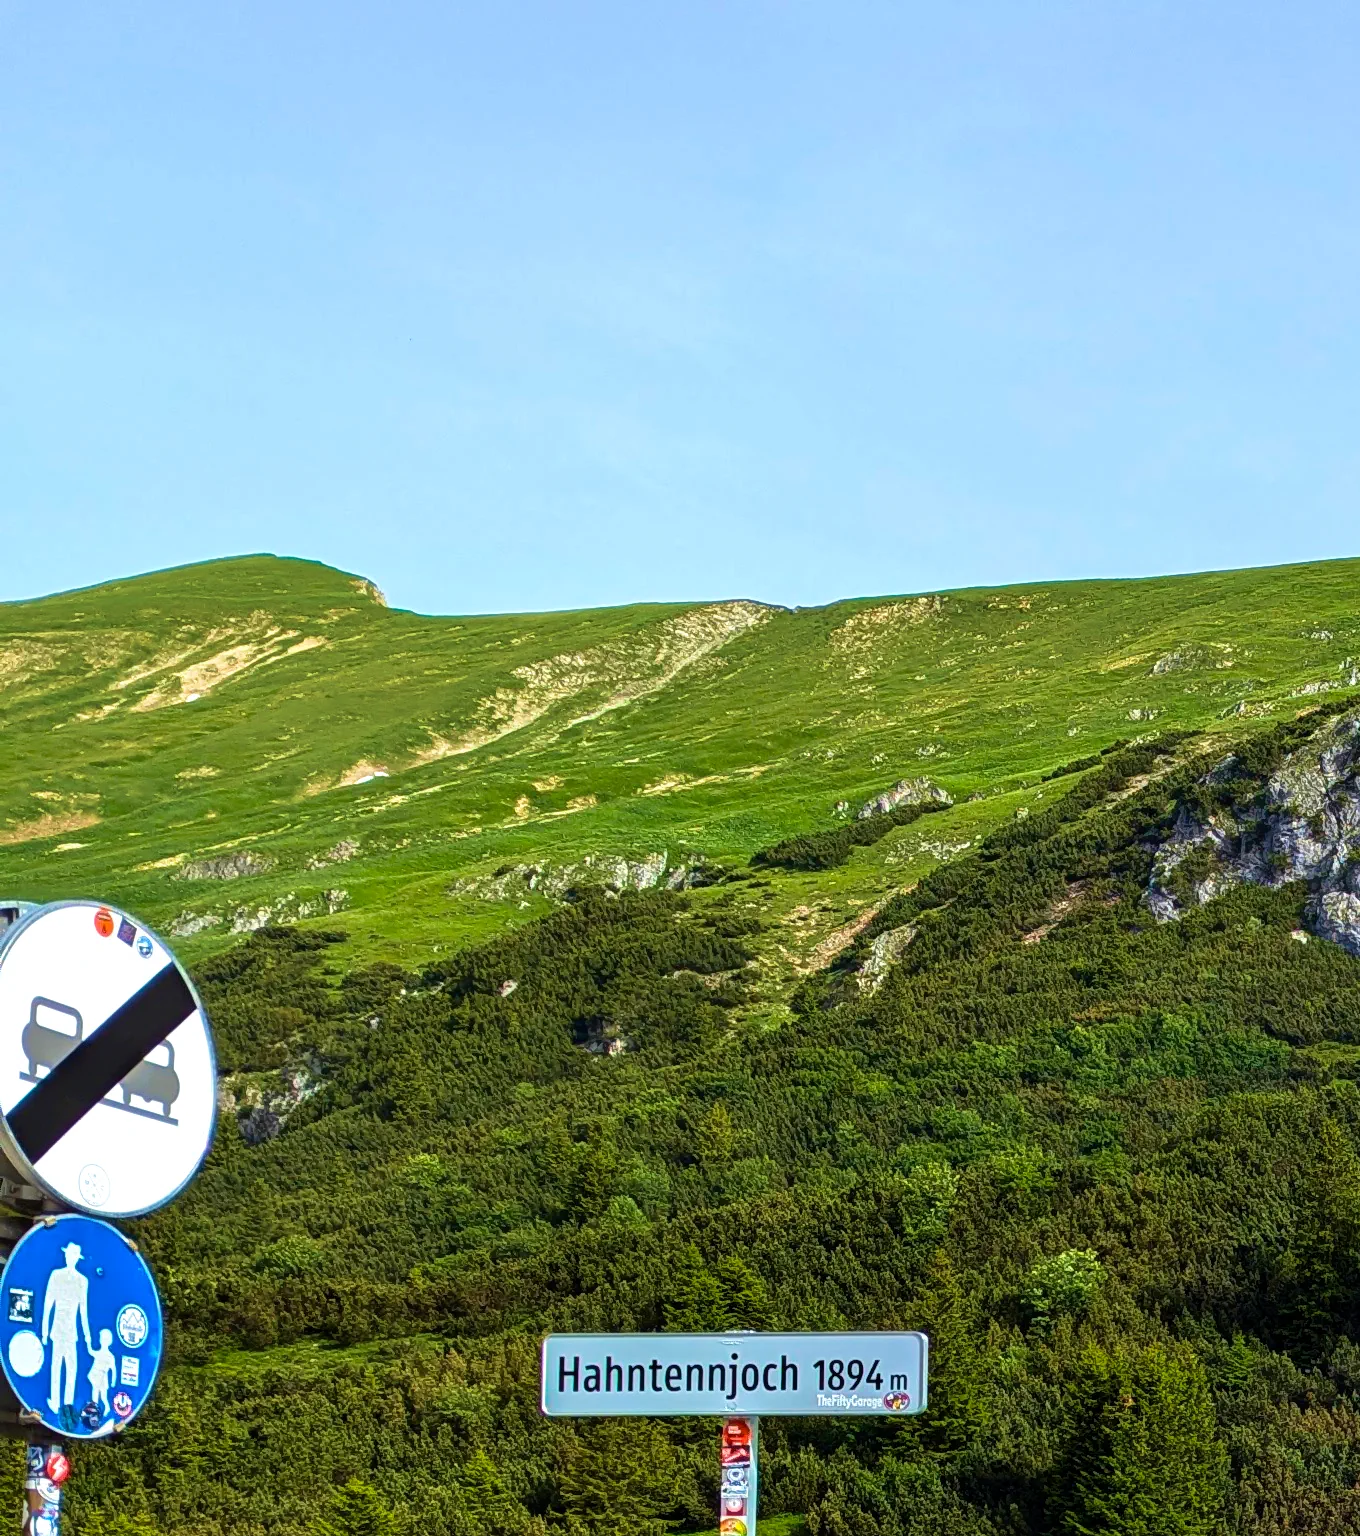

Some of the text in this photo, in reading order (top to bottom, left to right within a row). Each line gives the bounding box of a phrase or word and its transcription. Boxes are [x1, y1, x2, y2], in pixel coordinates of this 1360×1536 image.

[558, 1353, 908, 1400] Hahntennjoch 1894 m
[817, 1394, 883, 1409] TheFiftyGarage
